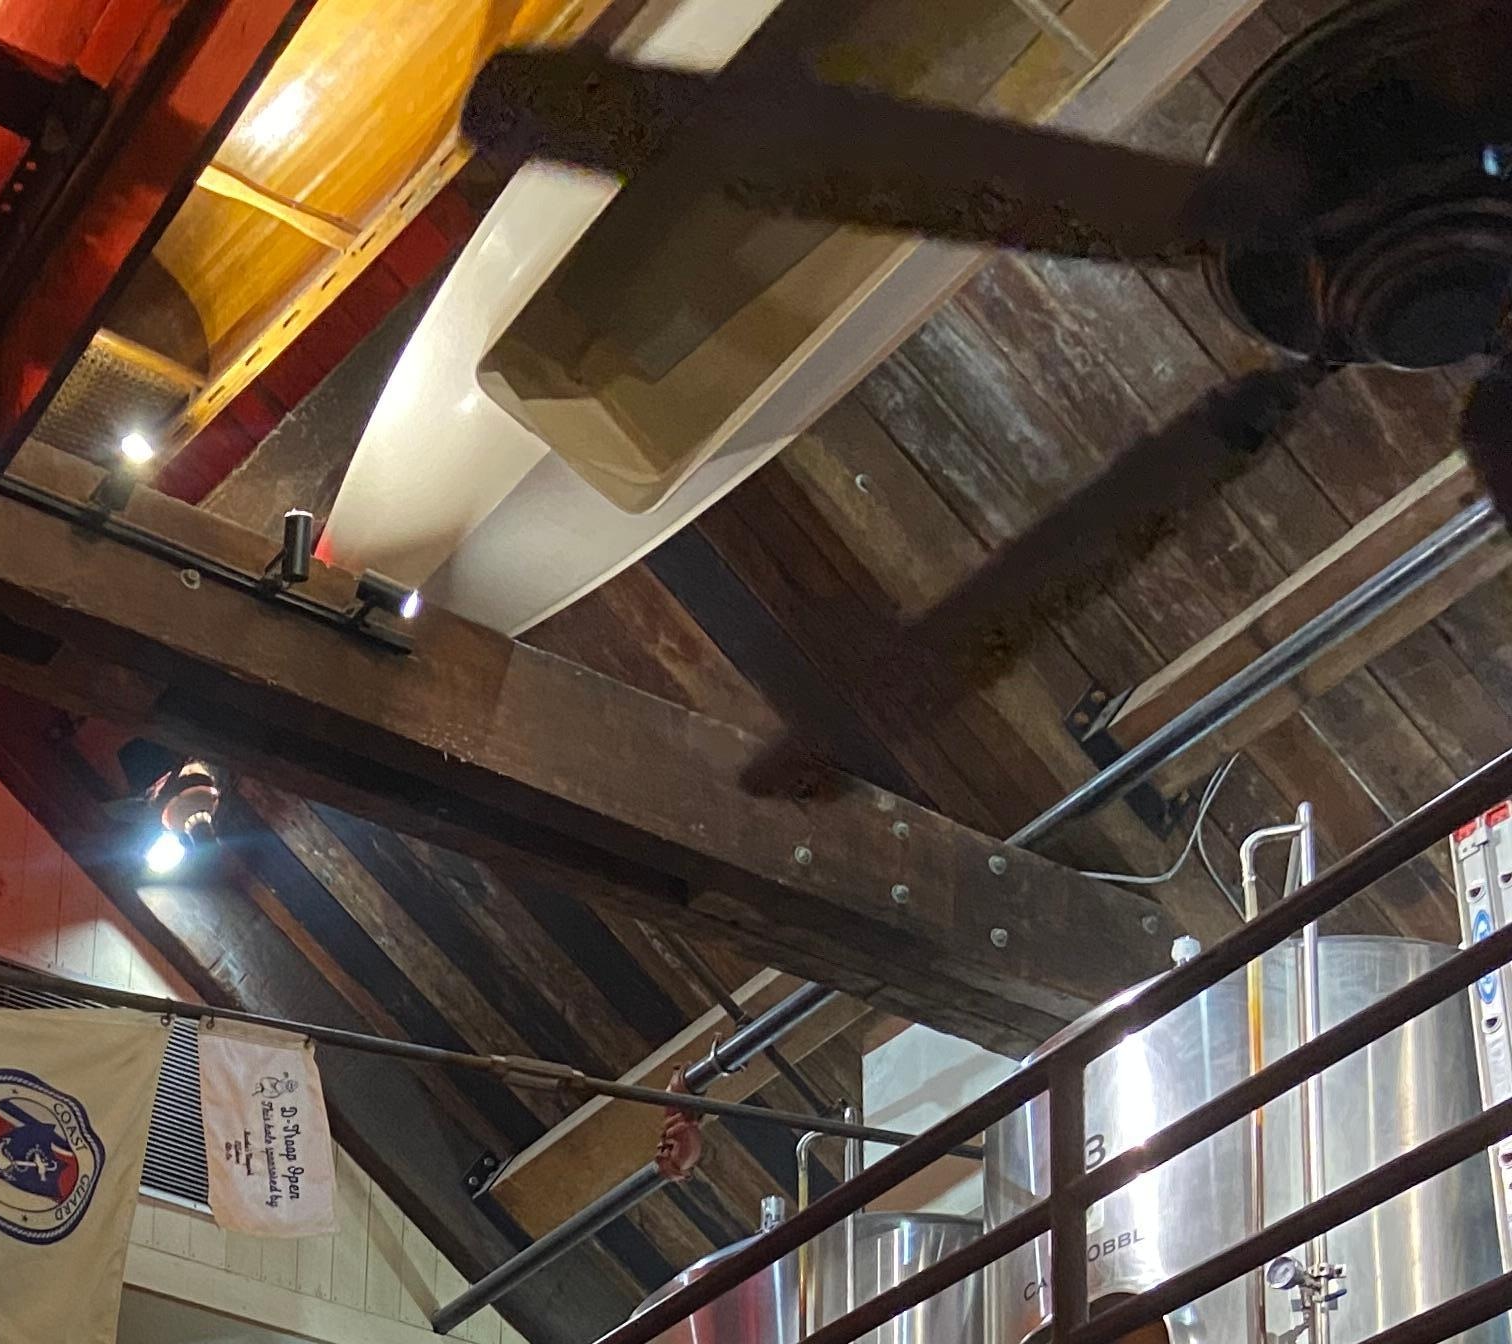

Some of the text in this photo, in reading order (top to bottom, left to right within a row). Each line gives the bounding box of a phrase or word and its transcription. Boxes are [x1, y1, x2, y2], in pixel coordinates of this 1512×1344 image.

[261, 1100, 274, 1121] This
[52, 1102, 90, 1221] COAST GUARD
[281, 1166, 305, 1201] Open
